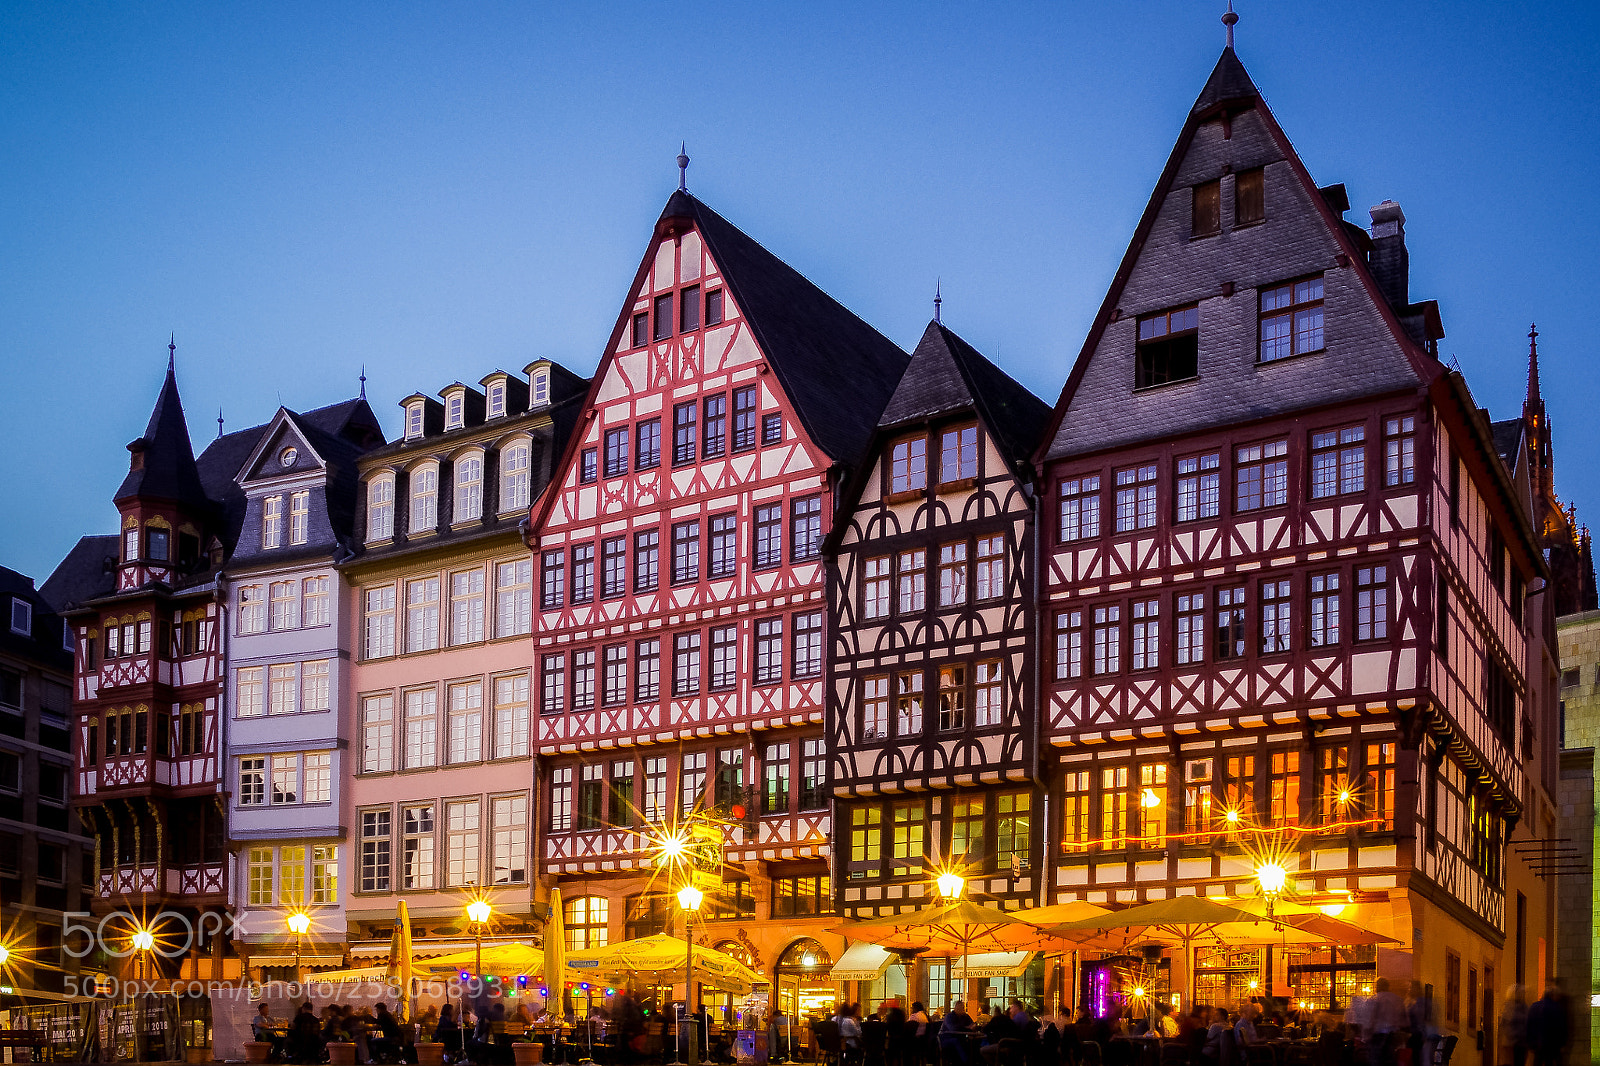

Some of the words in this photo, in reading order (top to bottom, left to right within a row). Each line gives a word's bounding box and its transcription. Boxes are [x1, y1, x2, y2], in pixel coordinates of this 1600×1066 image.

[151, 1021, 168, 1031] 2018
[52, 1030, 66, 1039] MAI
[66, 1028, 84, 1038] 208
